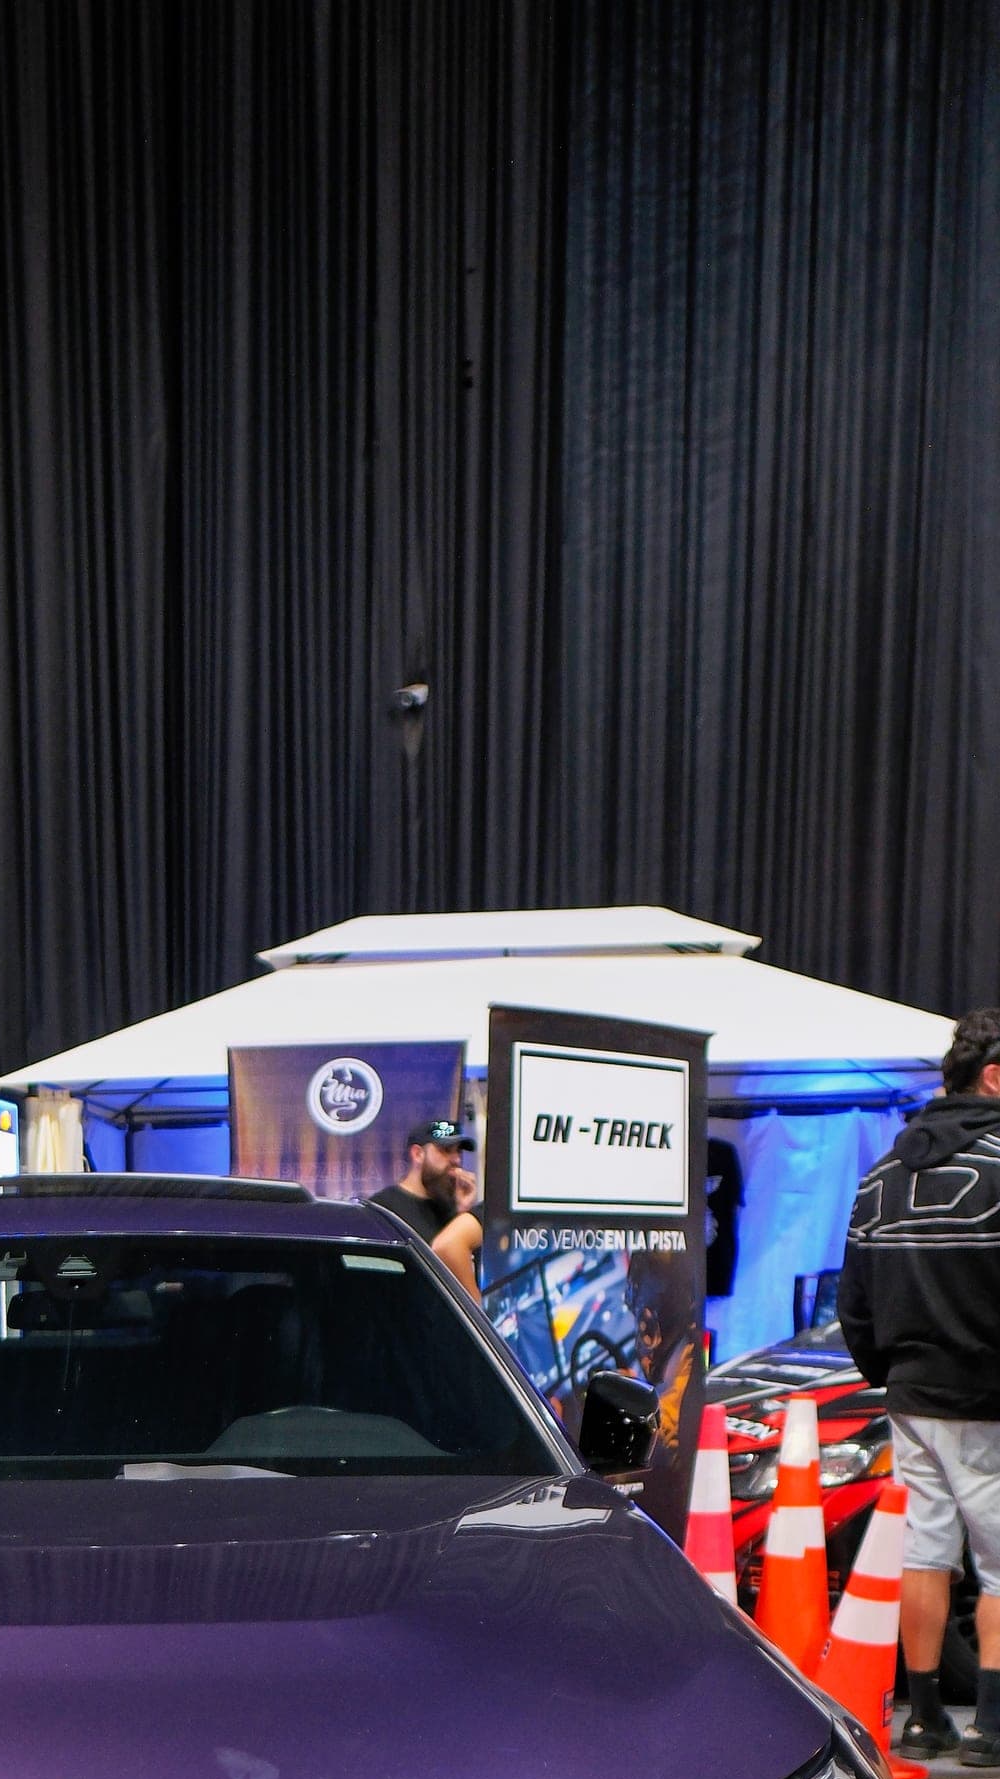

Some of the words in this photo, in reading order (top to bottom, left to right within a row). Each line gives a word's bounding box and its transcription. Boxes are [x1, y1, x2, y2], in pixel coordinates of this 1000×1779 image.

[514, 1228, 548, 1250] NOS
[629, 1231, 647, 1250] LA
[650, 1231, 687, 1251] PISTA
